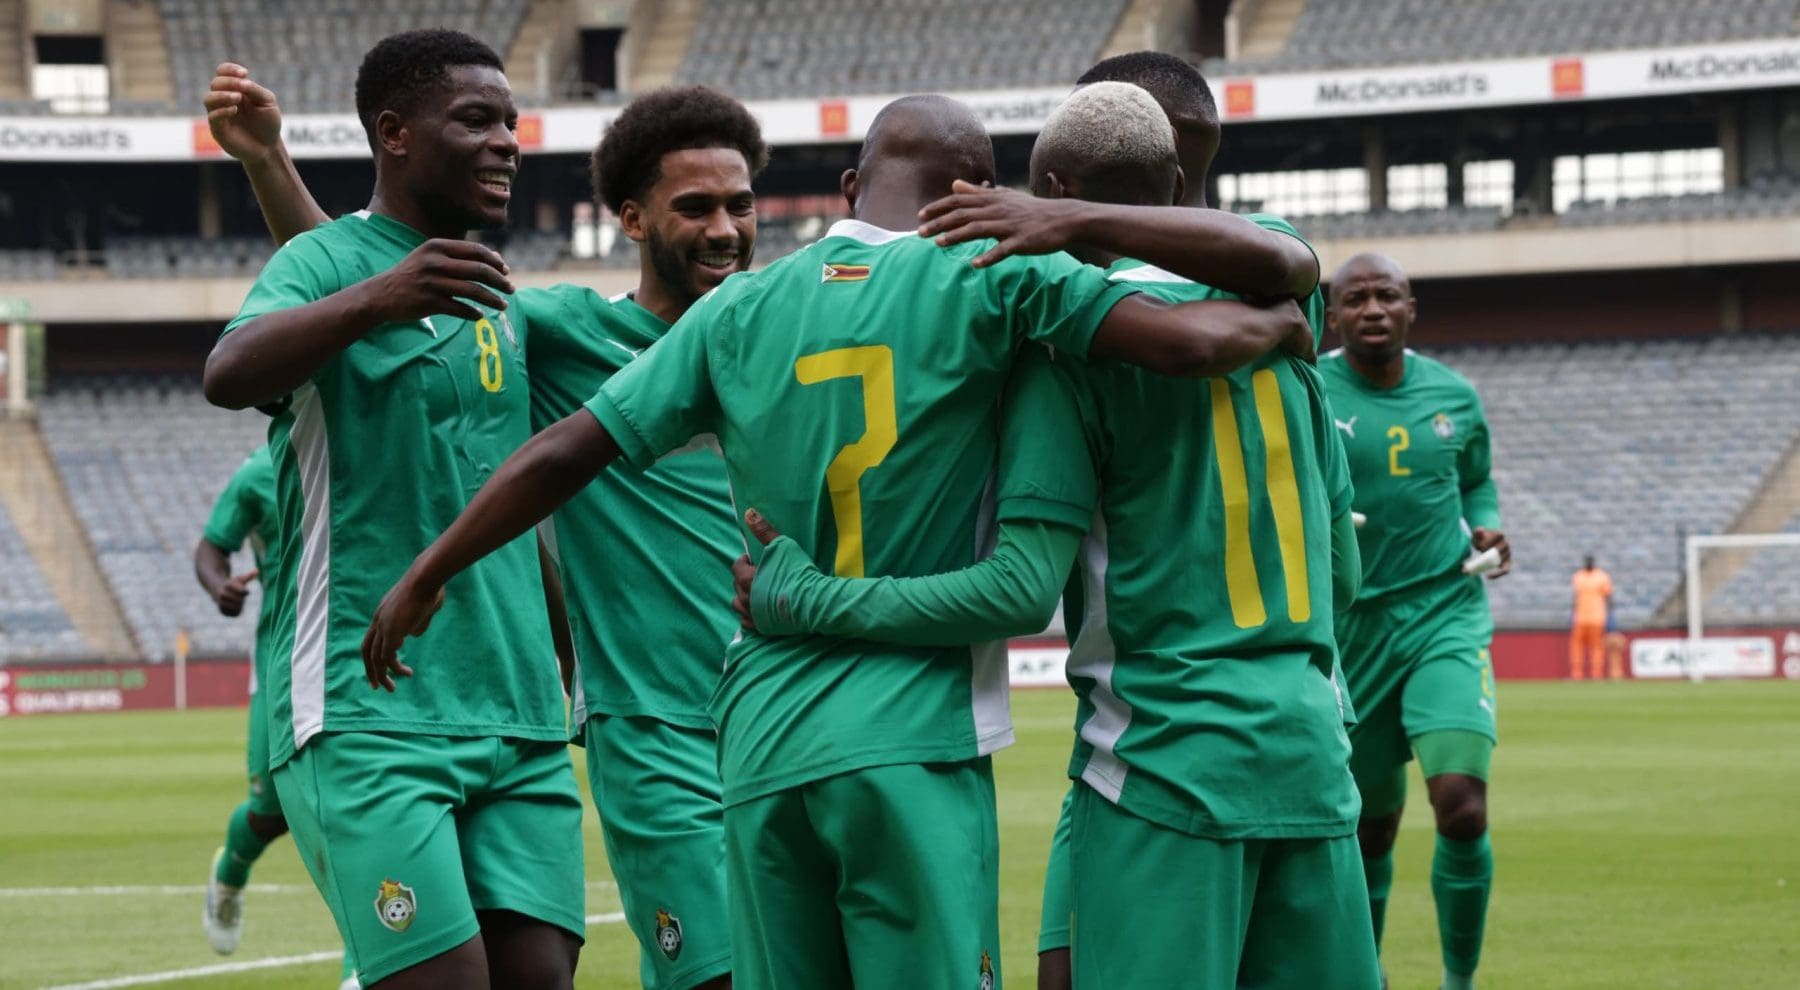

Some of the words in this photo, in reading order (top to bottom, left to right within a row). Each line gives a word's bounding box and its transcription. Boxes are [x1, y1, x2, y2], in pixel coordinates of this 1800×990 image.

[1316, 71, 1488, 101] McDonald's
[475, 318, 503, 392] 8
[795, 345, 898, 578] 7
[1386, 424, 1411, 476] 2
[1210, 368, 1311, 628] 11
